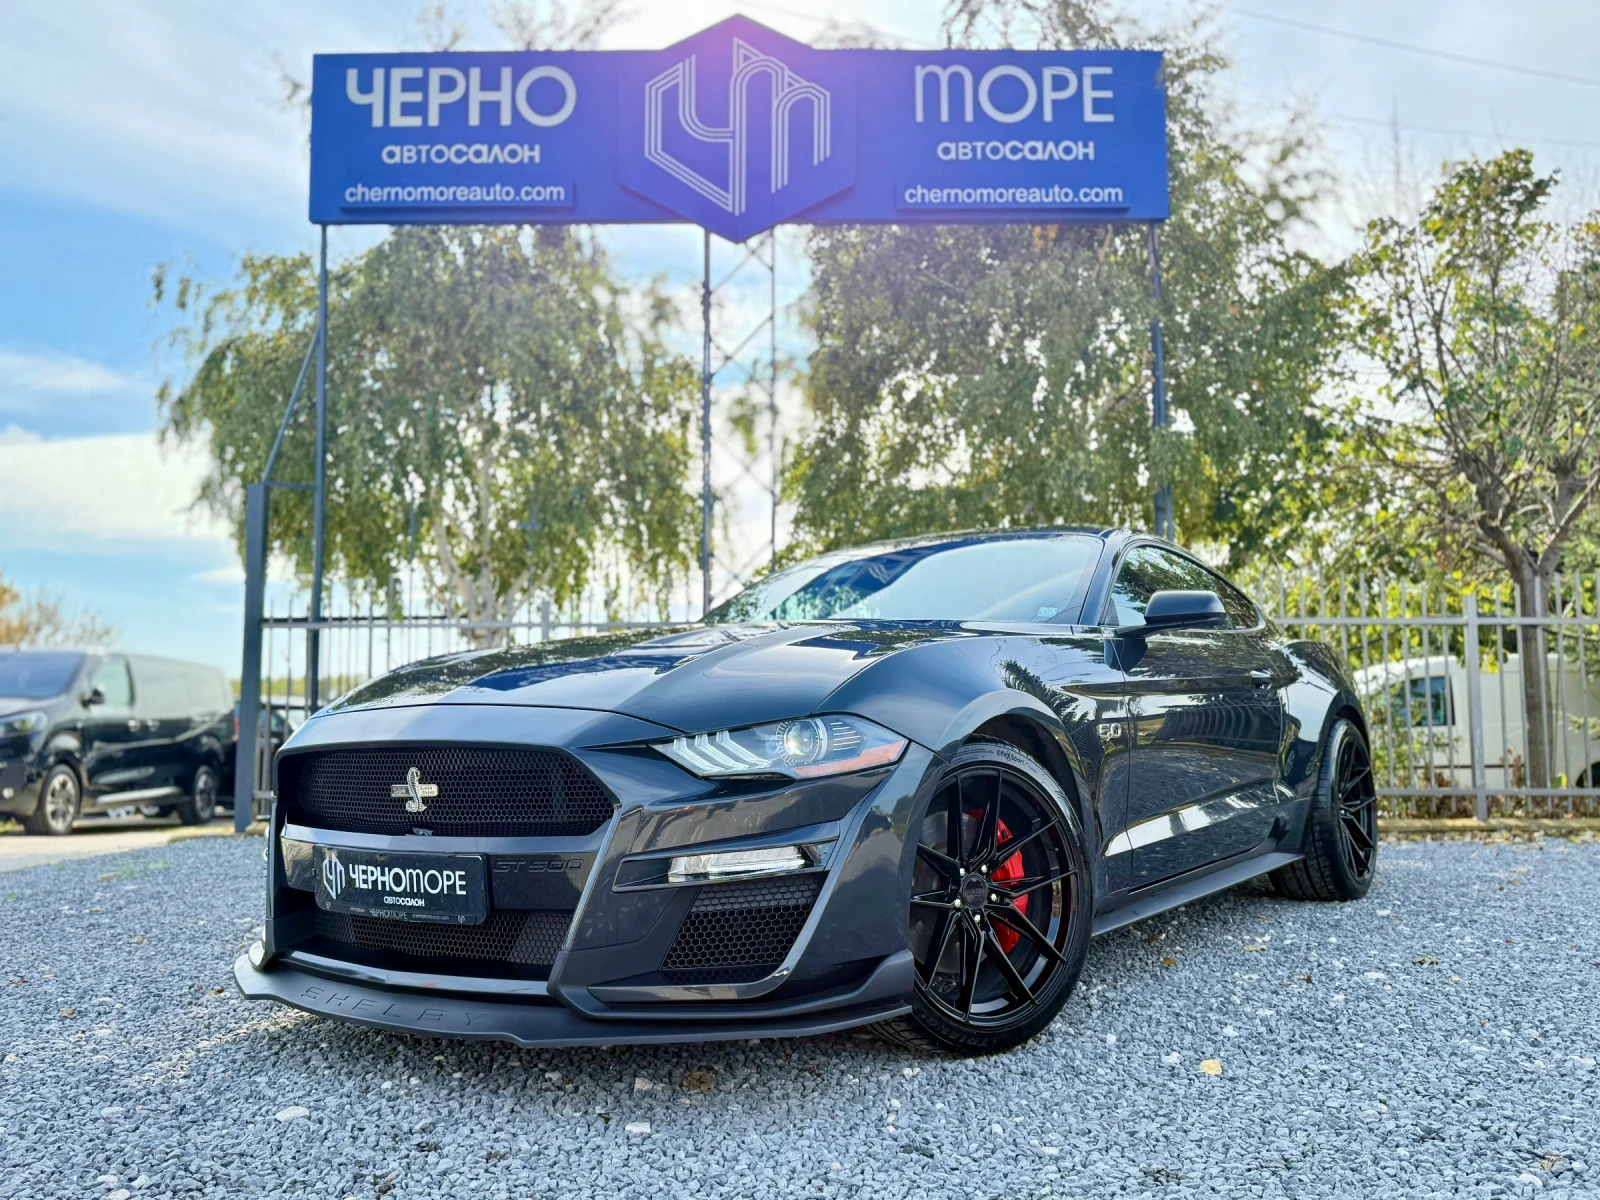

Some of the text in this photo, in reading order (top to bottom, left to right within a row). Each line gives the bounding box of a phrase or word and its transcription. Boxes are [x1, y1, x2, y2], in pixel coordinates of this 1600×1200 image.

[345, 65, 577, 128] ЧЕРНО
[344, 183, 565, 203] chernomoreauto.com
[904, 184, 1123, 204] chernomoreauto.com
[493, 859, 585, 873] GT 500
[300, 986, 490, 1027] SHELBY
